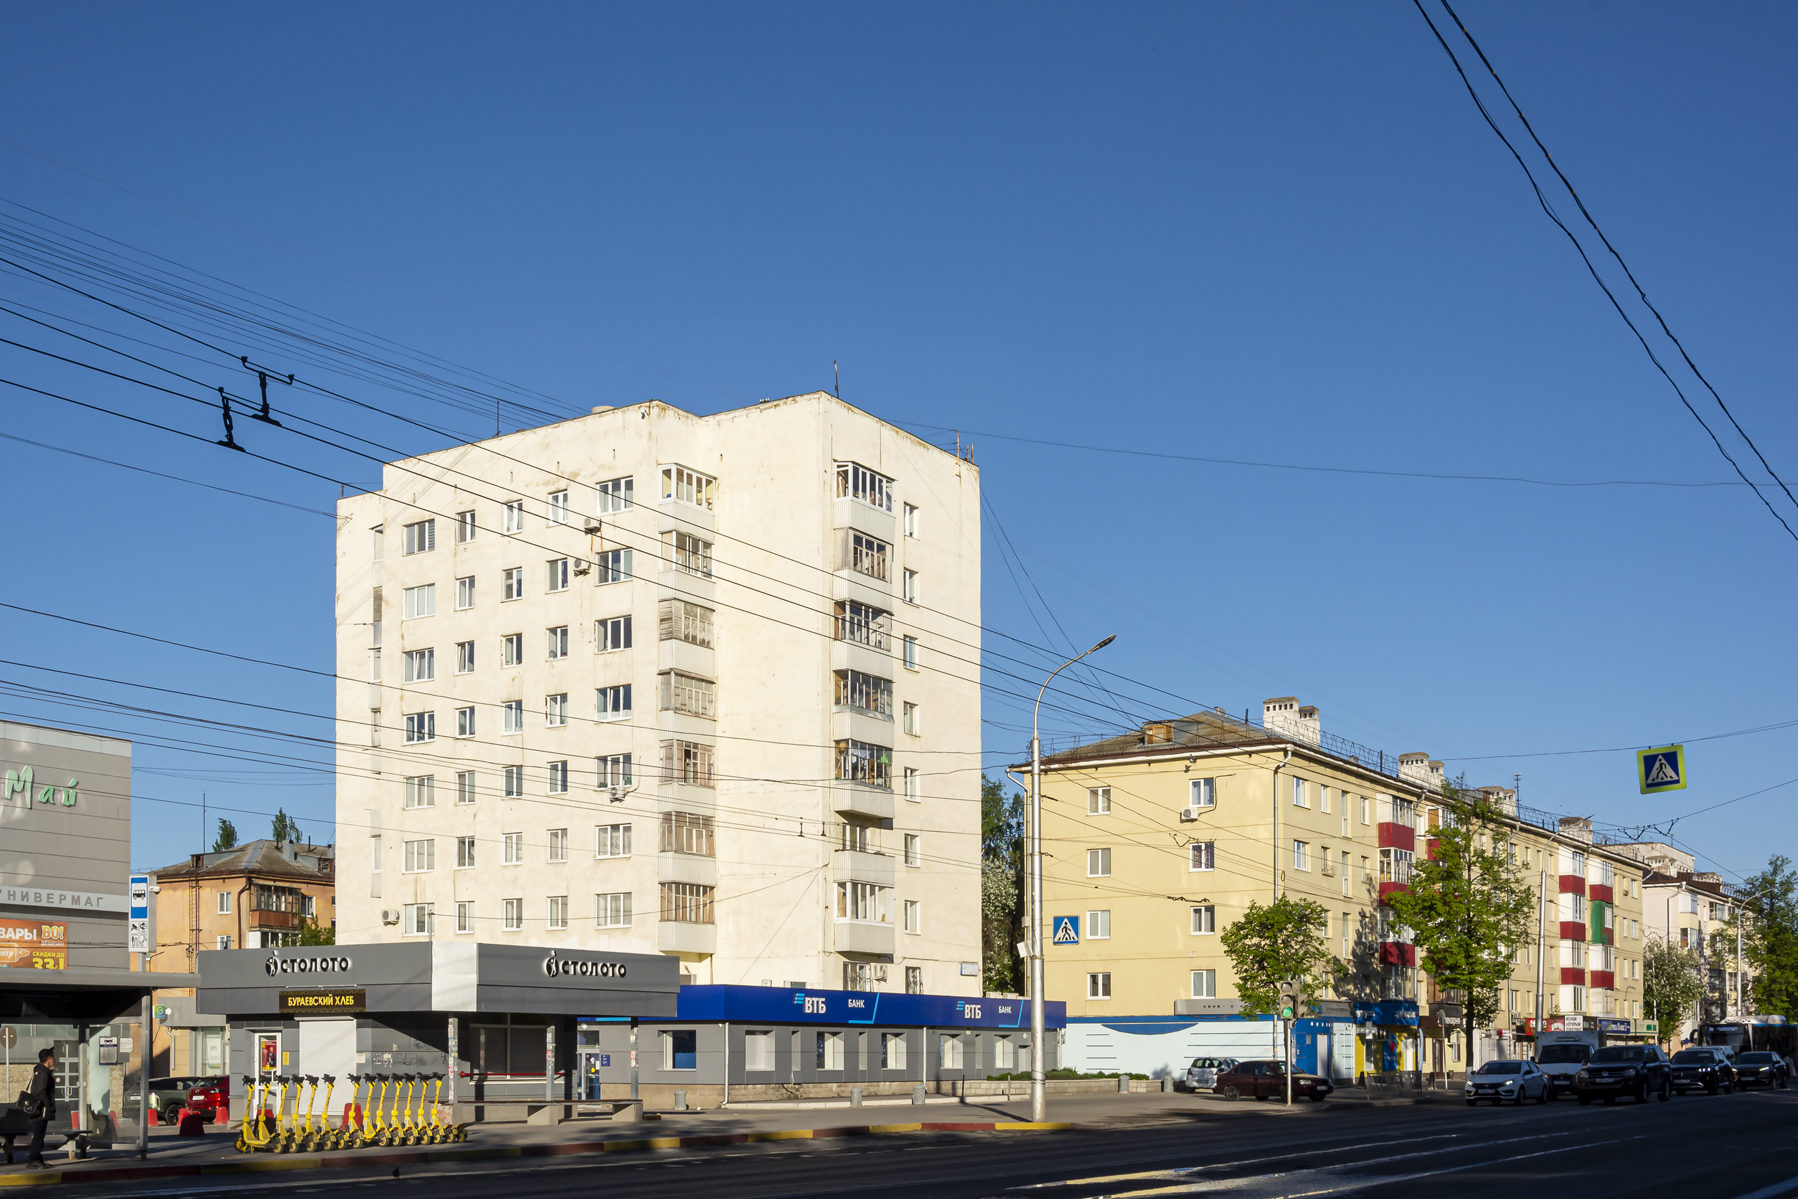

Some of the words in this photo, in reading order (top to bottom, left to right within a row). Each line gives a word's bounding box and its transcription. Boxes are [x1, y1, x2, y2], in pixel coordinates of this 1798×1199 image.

[5, 765, 78, 809] Май
[288, 994, 333, 1006] БУРАЕВСКИЙ
[335, 996, 354, 1005] ХЛЕБ
[804, 997, 826, 1014] ВТБ
[848, 998, 865, 1008] БАНК
[964, 1005, 981, 1019] ВТБ
[998, 1005, 1012, 1014] БАНК
